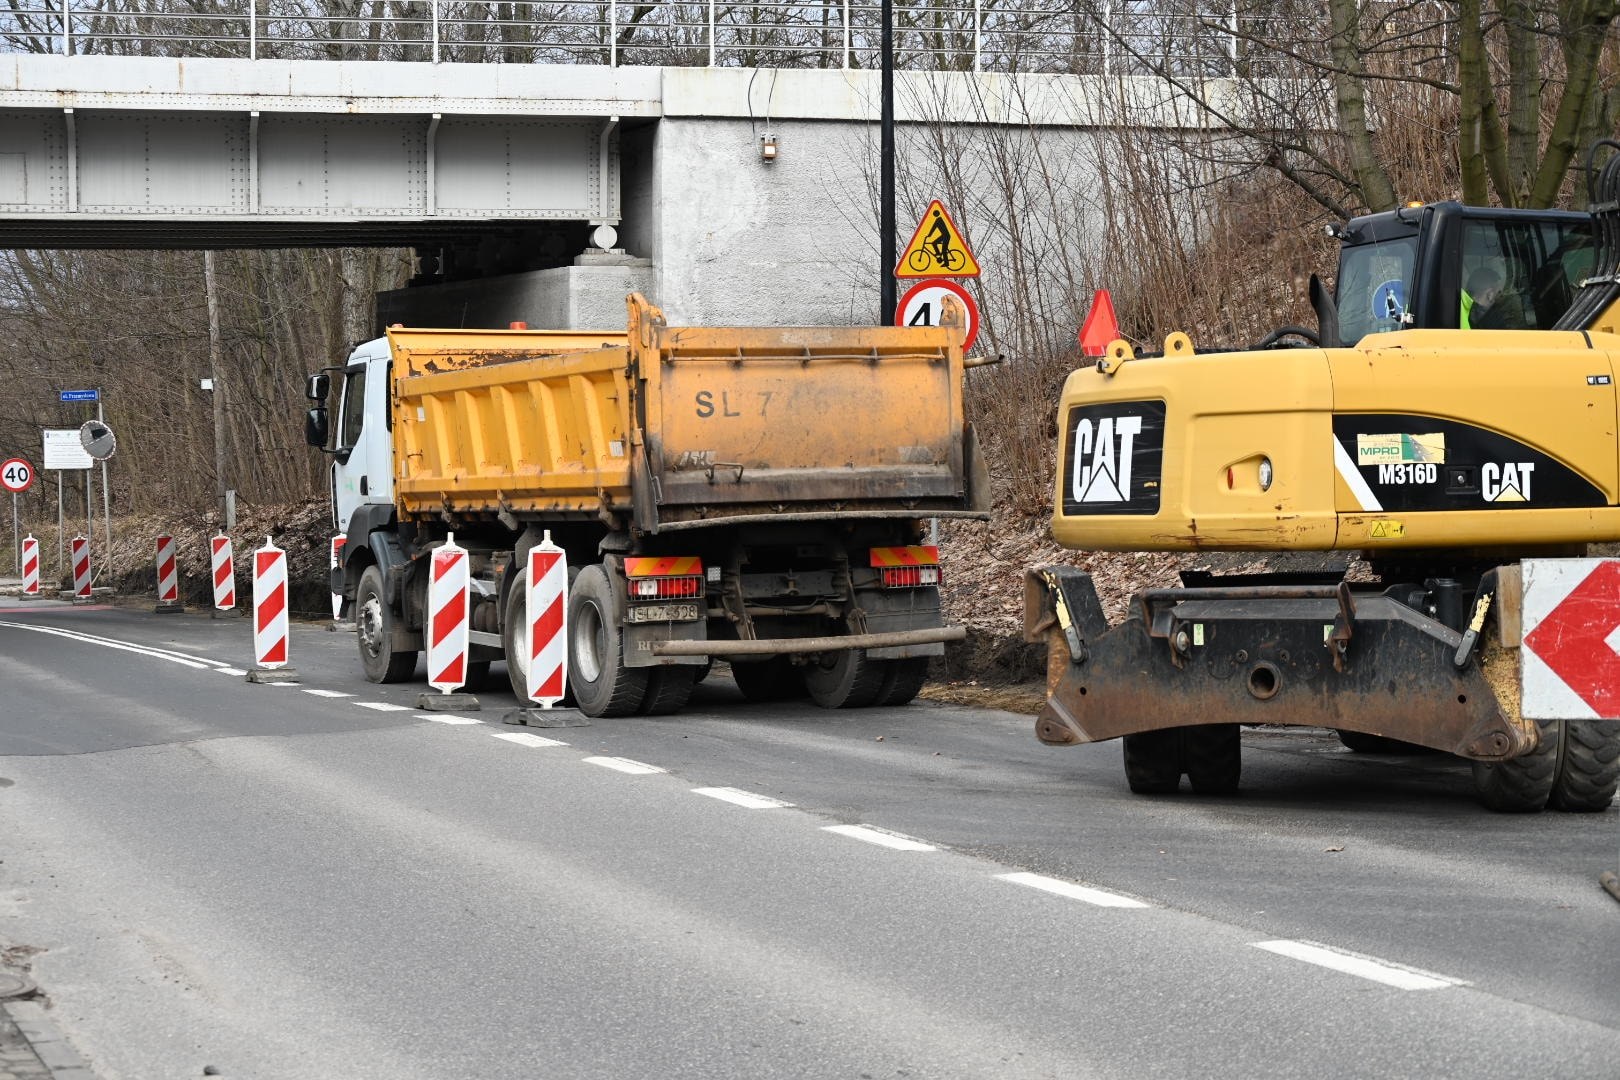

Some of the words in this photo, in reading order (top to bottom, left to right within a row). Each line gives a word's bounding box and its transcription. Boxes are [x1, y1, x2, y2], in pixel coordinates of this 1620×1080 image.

[909, 303, 940, 326] 4
[1073, 416, 1142, 503] CAT
[1361, 446, 1400, 456] MPRO
[5, 467, 28, 482] 40
[1379, 464, 1437, 484] M316D
[1481, 462, 1535, 502] CAT
